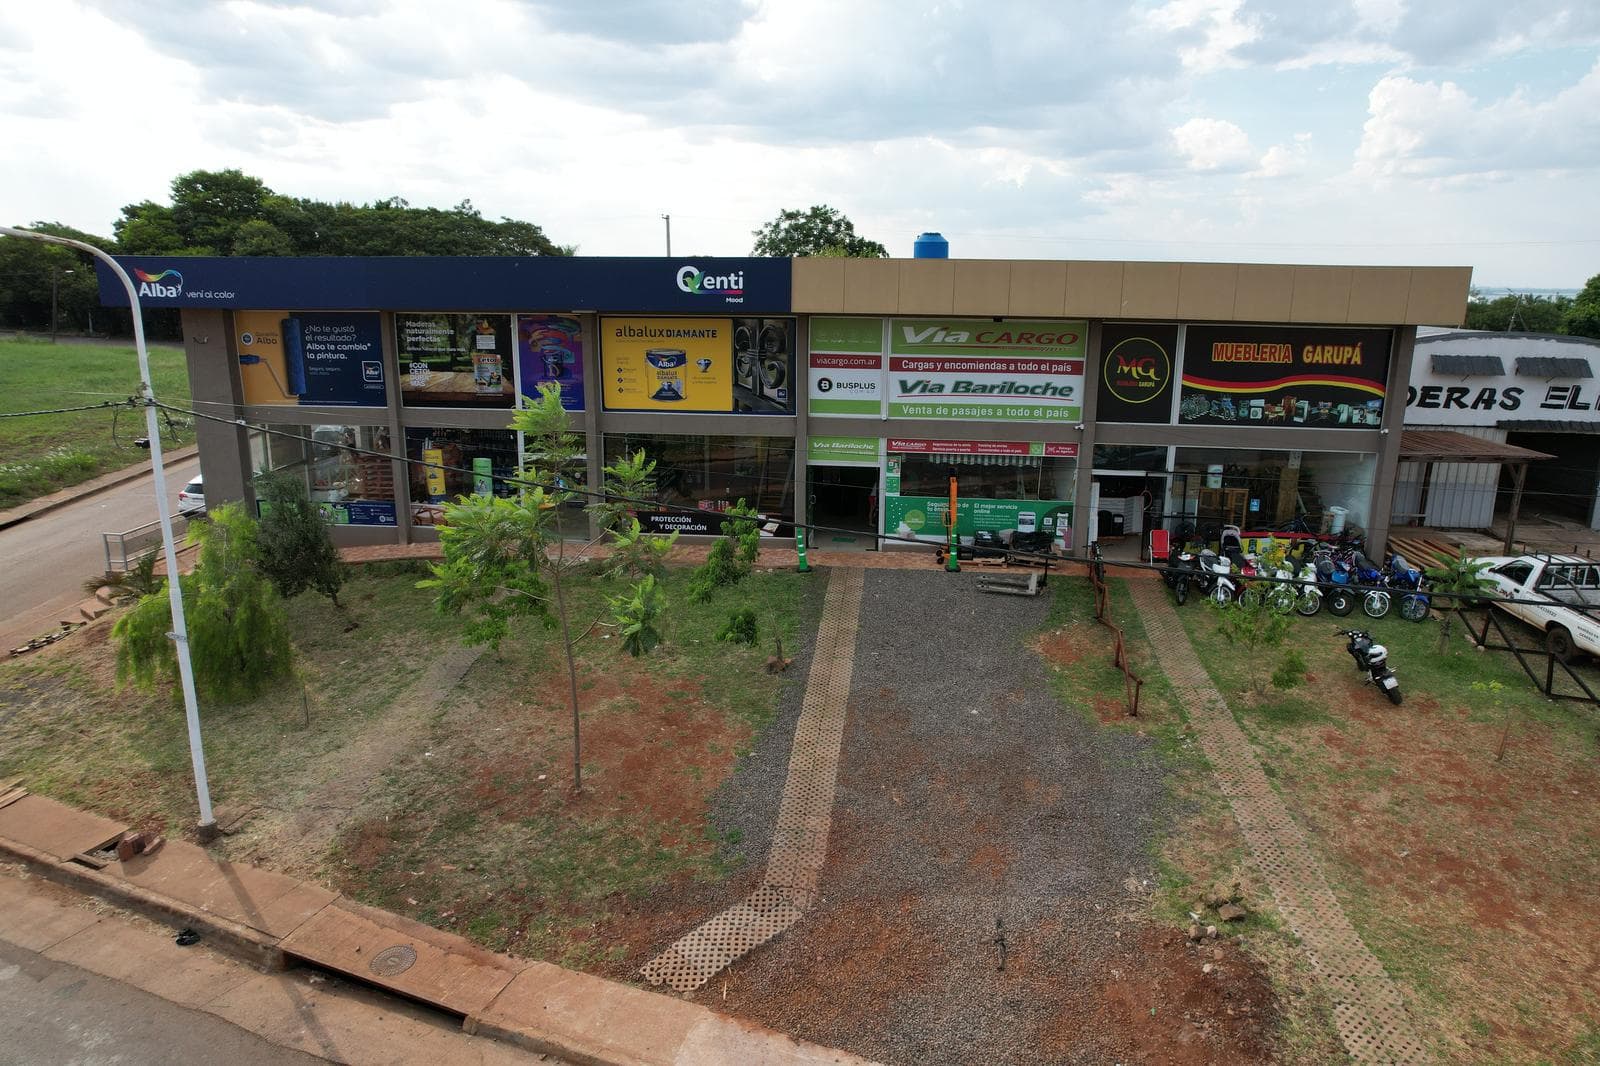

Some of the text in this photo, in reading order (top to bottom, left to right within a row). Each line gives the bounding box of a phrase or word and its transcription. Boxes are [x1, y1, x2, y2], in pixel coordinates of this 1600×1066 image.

[676, 266, 744, 292] Qenti
[139, 282, 177, 298] Alba
[305, 325, 320, 334] ¿No
[976, 331, 1078, 345] CARGO
[1212, 341, 1363, 365] MUEBLERIA GARUPÁ
[816, 358, 876, 366] viacargo.com.ar
[902, 360, 934, 370] Cargas
[936, 362, 942, 370] y
[944, 361, 1006, 370] encomiendas
[1017, 362, 1038, 371] todo
[1040, 362, 1049, 371] el
[1052, 362, 1072, 373] país
[1116, 352, 1160, 380] MG
[951, 380, 1074, 397] Bariloche
[1540, 384, 1600, 410] EL
[902, 405, 932, 415] Venta
[936, 405, 948, 415] de
[952, 406, 992, 418] pasajes
[1006, 406, 1030, 417] todo
[1034, 406, 1043, 417] el
[1046, 408, 1069, 420] país
[651, 515, 692, 523] PROTECCIÓN
[665, 523, 707, 531] DECORACIÓN
